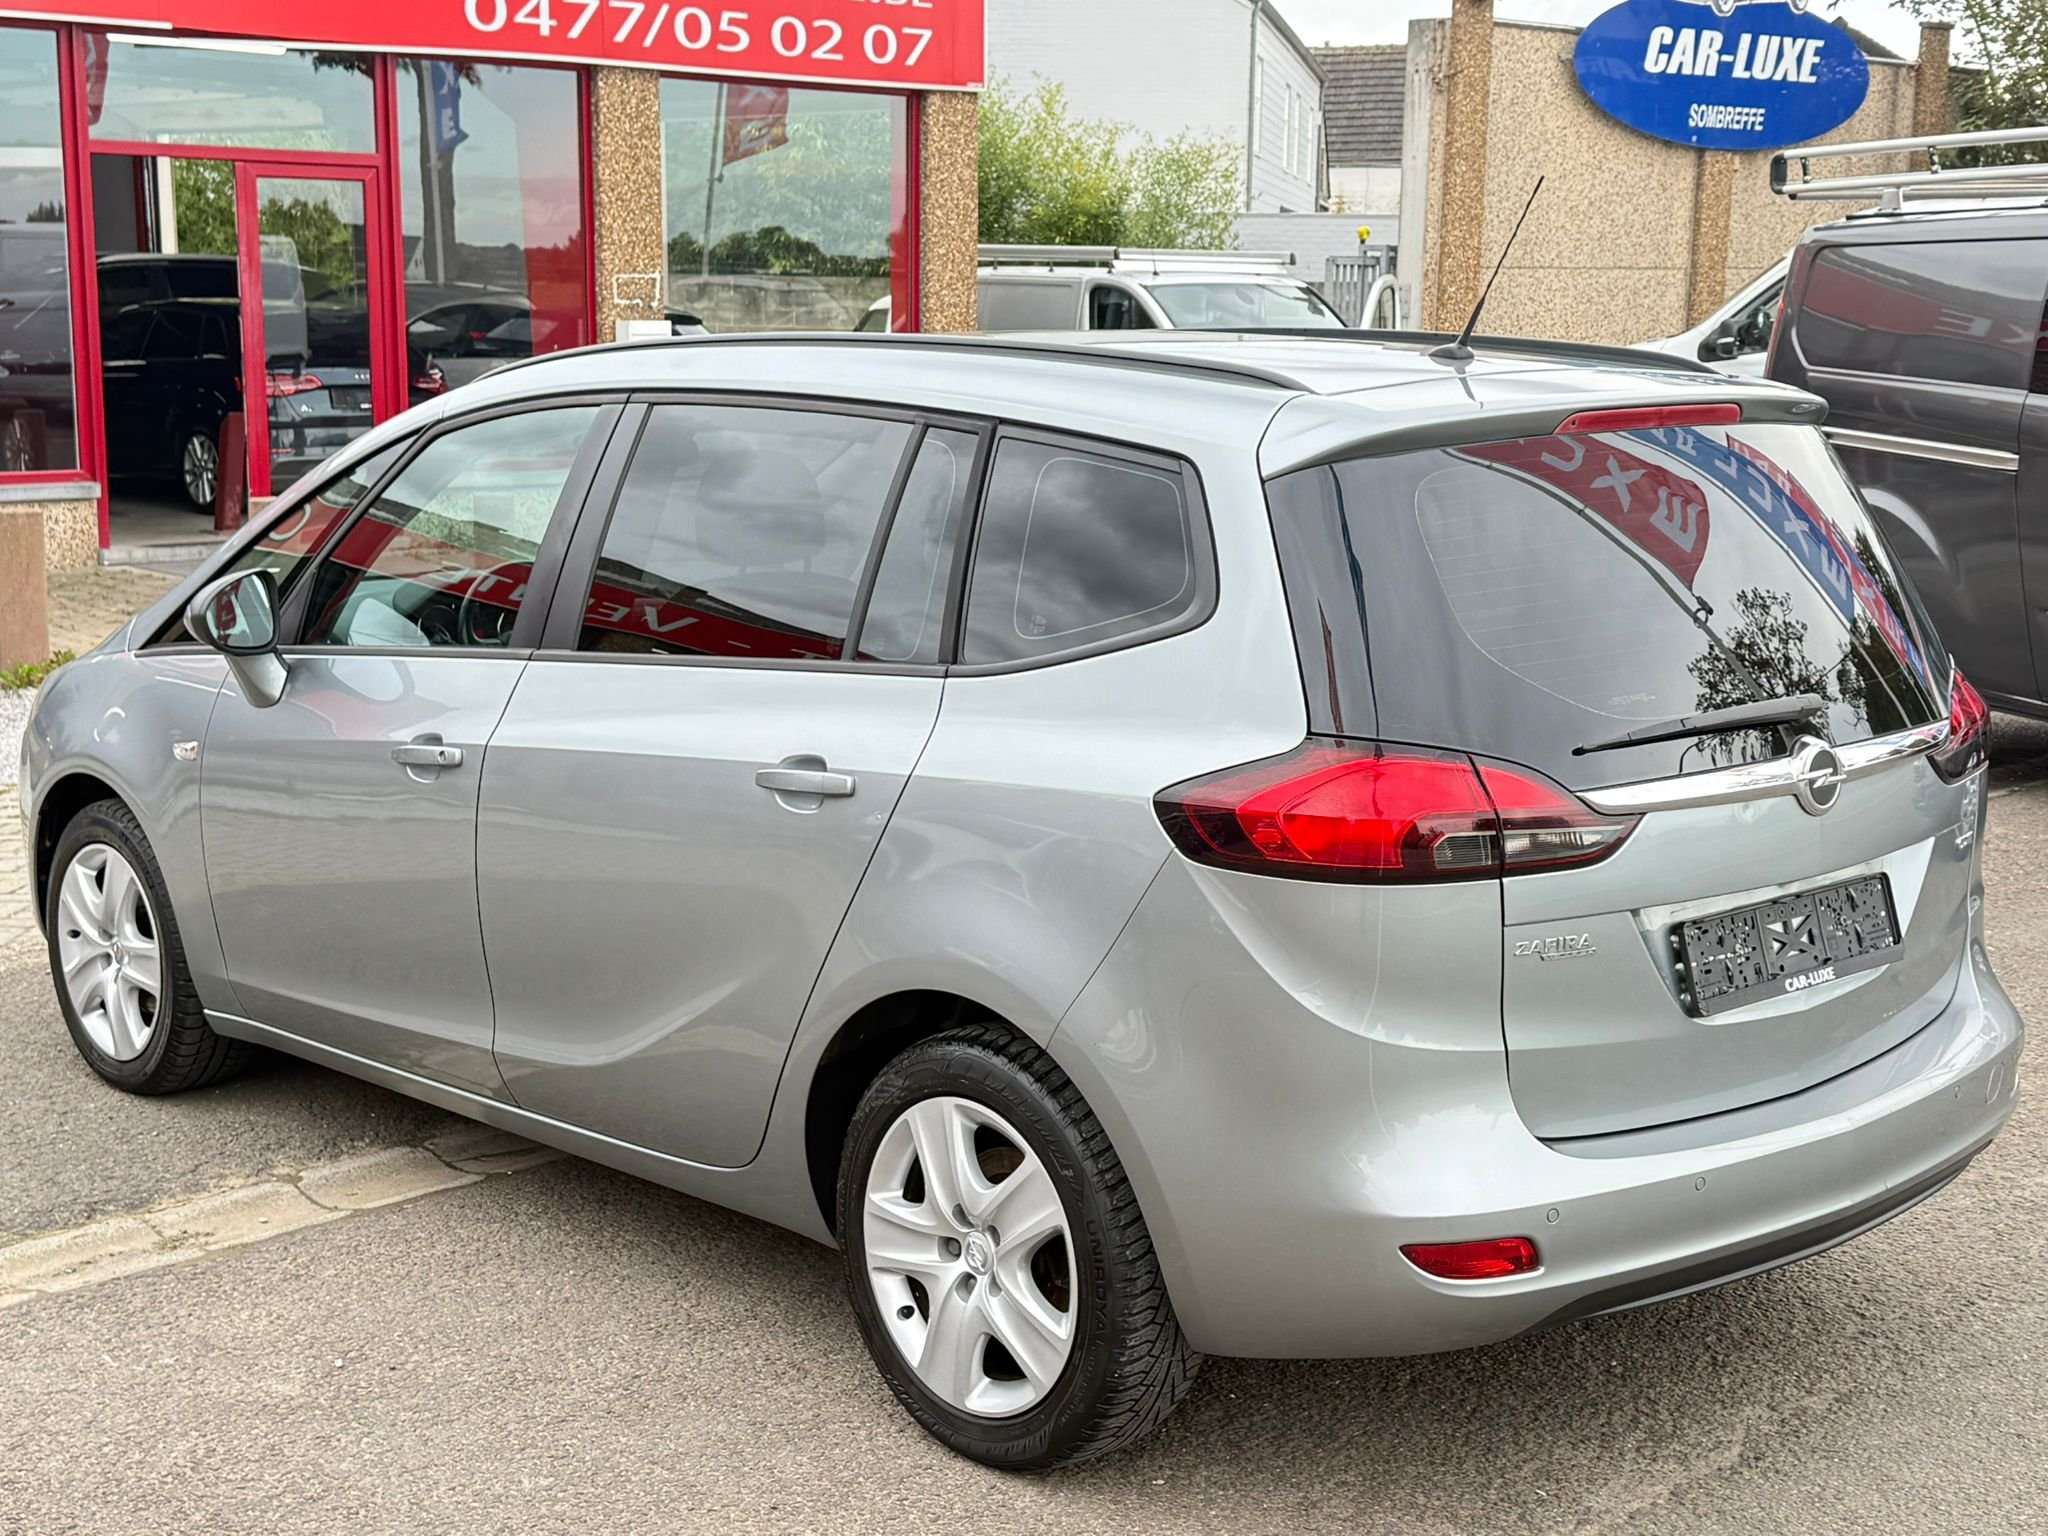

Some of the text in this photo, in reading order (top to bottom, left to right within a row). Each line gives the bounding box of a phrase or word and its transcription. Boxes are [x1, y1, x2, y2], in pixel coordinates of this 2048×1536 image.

[464, 0, 934, 67] 0477/05 02 07
[1643, 25, 1825, 83] CAR-LUXE
[1688, 103, 1766, 131] SOMBREFFE
[1513, 933, 1592, 957] ZAFIRA
[1784, 966, 1837, 992] CAR-LUXE
